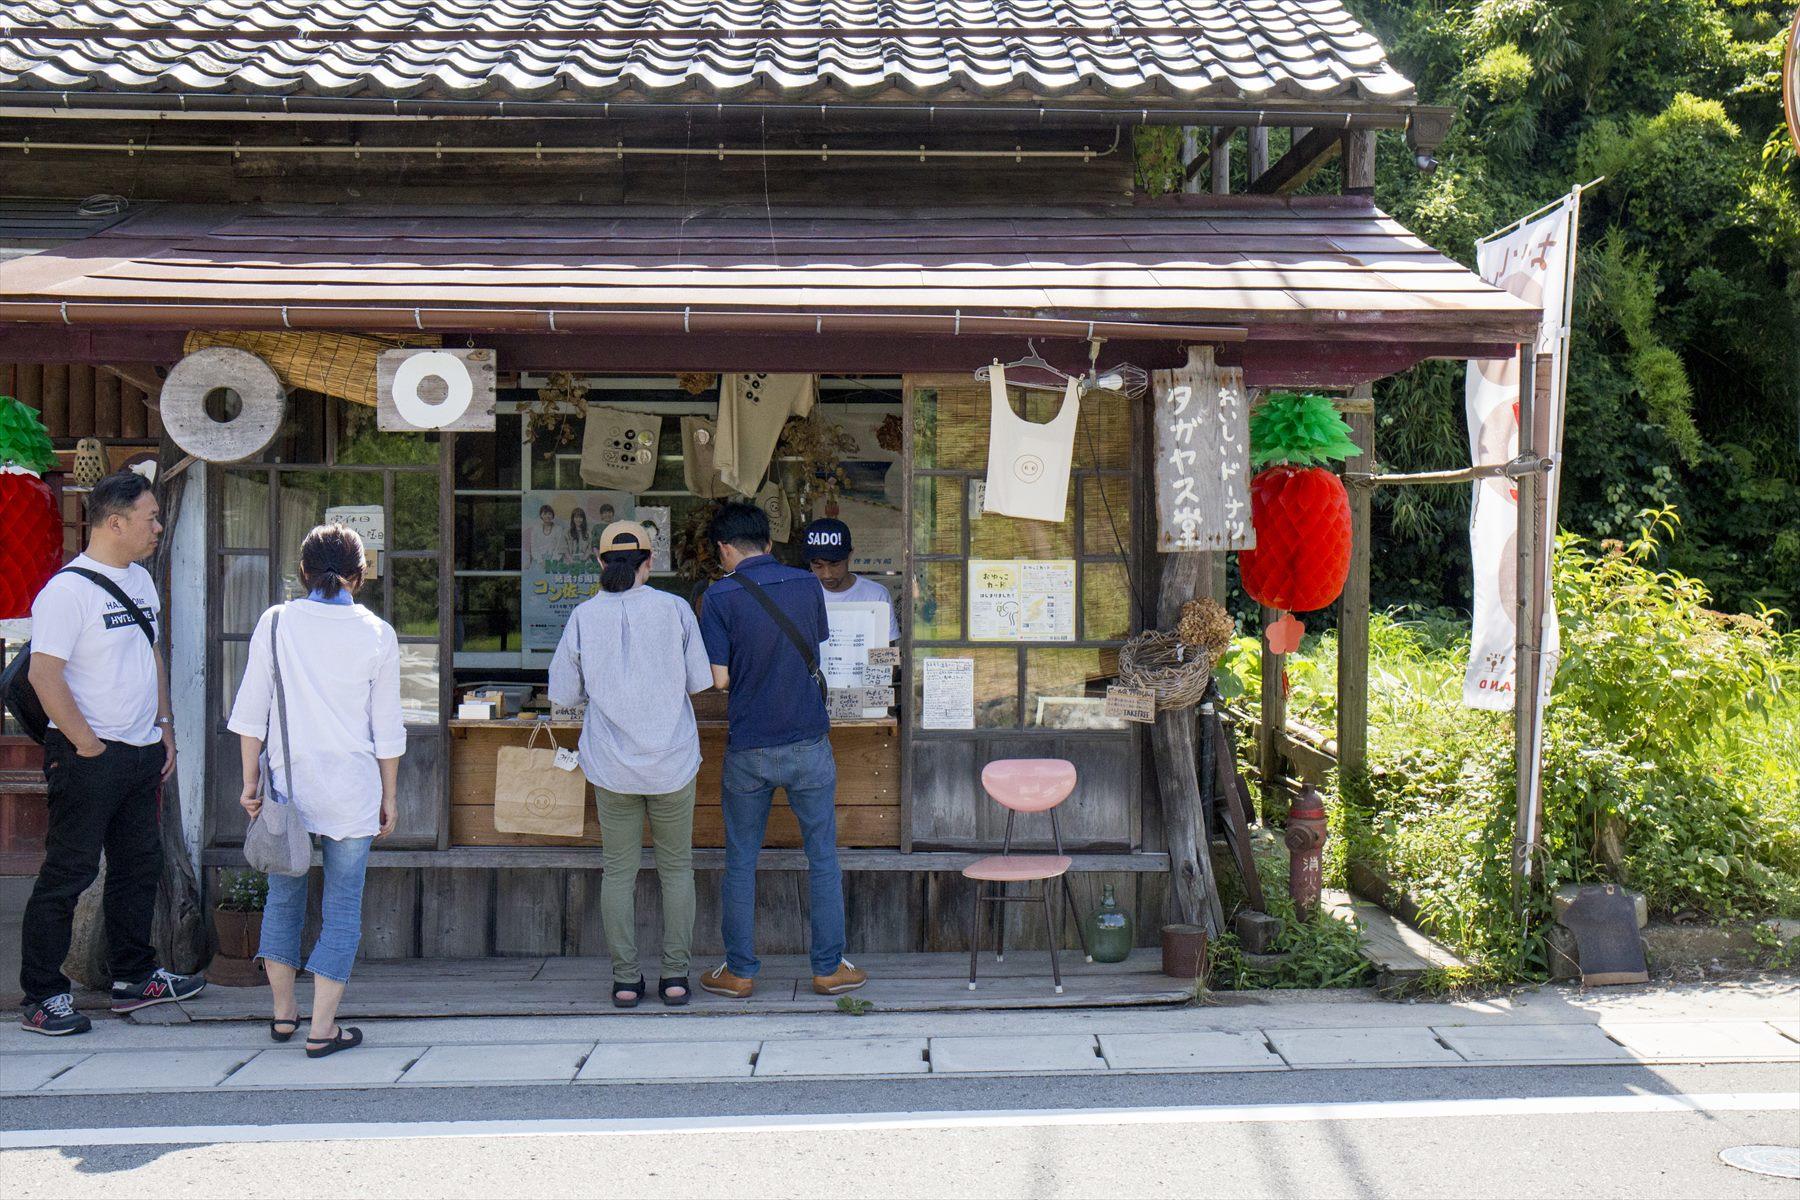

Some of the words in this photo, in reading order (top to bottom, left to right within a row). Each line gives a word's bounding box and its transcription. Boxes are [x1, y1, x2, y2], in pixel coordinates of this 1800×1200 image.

[1167, 386, 1203, 546] タガヤス堂
[1218, 387, 1244, 540] おいしいドーナツ
[807, 532, 842, 546] SADO!
[143, 981, 167, 997] N
[32, 1009, 48, 1026] N
